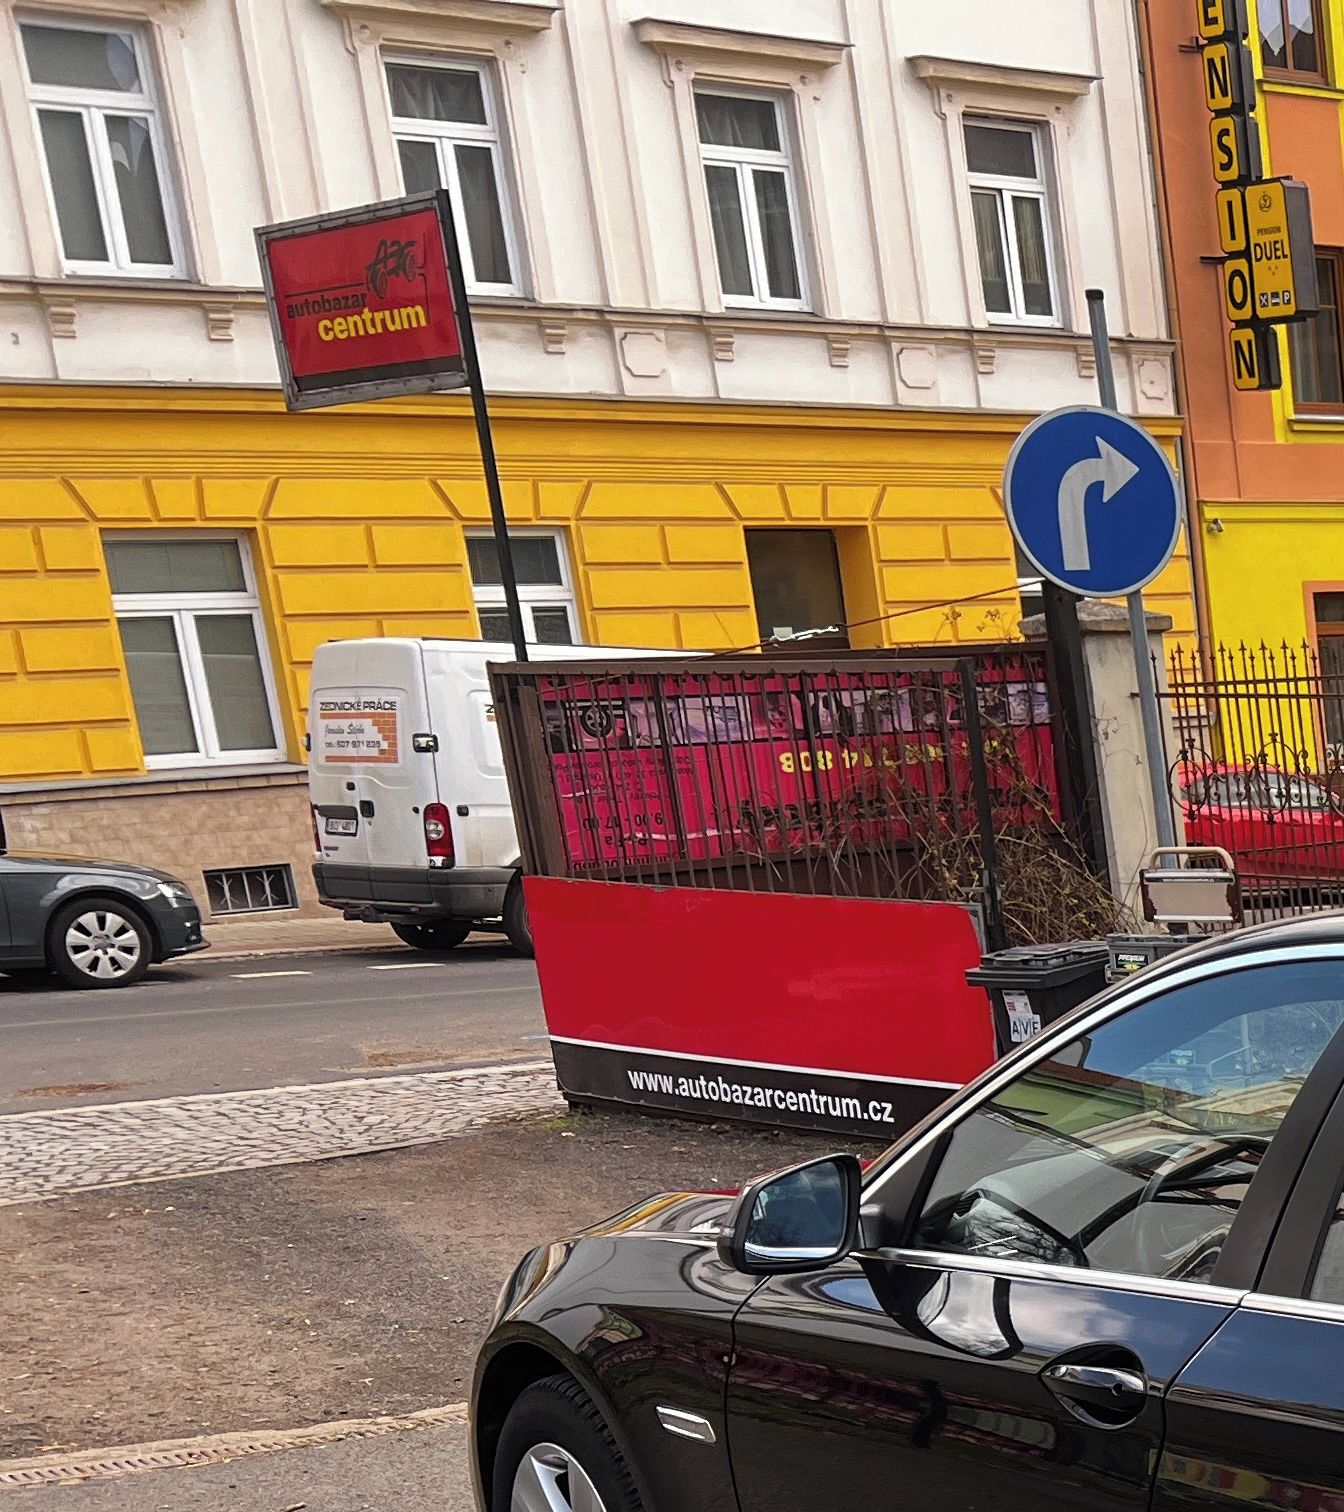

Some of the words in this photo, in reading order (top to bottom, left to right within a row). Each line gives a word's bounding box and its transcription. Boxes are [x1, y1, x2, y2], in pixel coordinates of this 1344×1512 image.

[1253, 239, 1288, 263] DUEL
[287, 292, 368, 319] autobazar
[318, 304, 427, 341] centrum
[363, 697, 397, 711] PRÁCE
[627, 1070, 895, 1123] www.autobazarcentrum.cz
